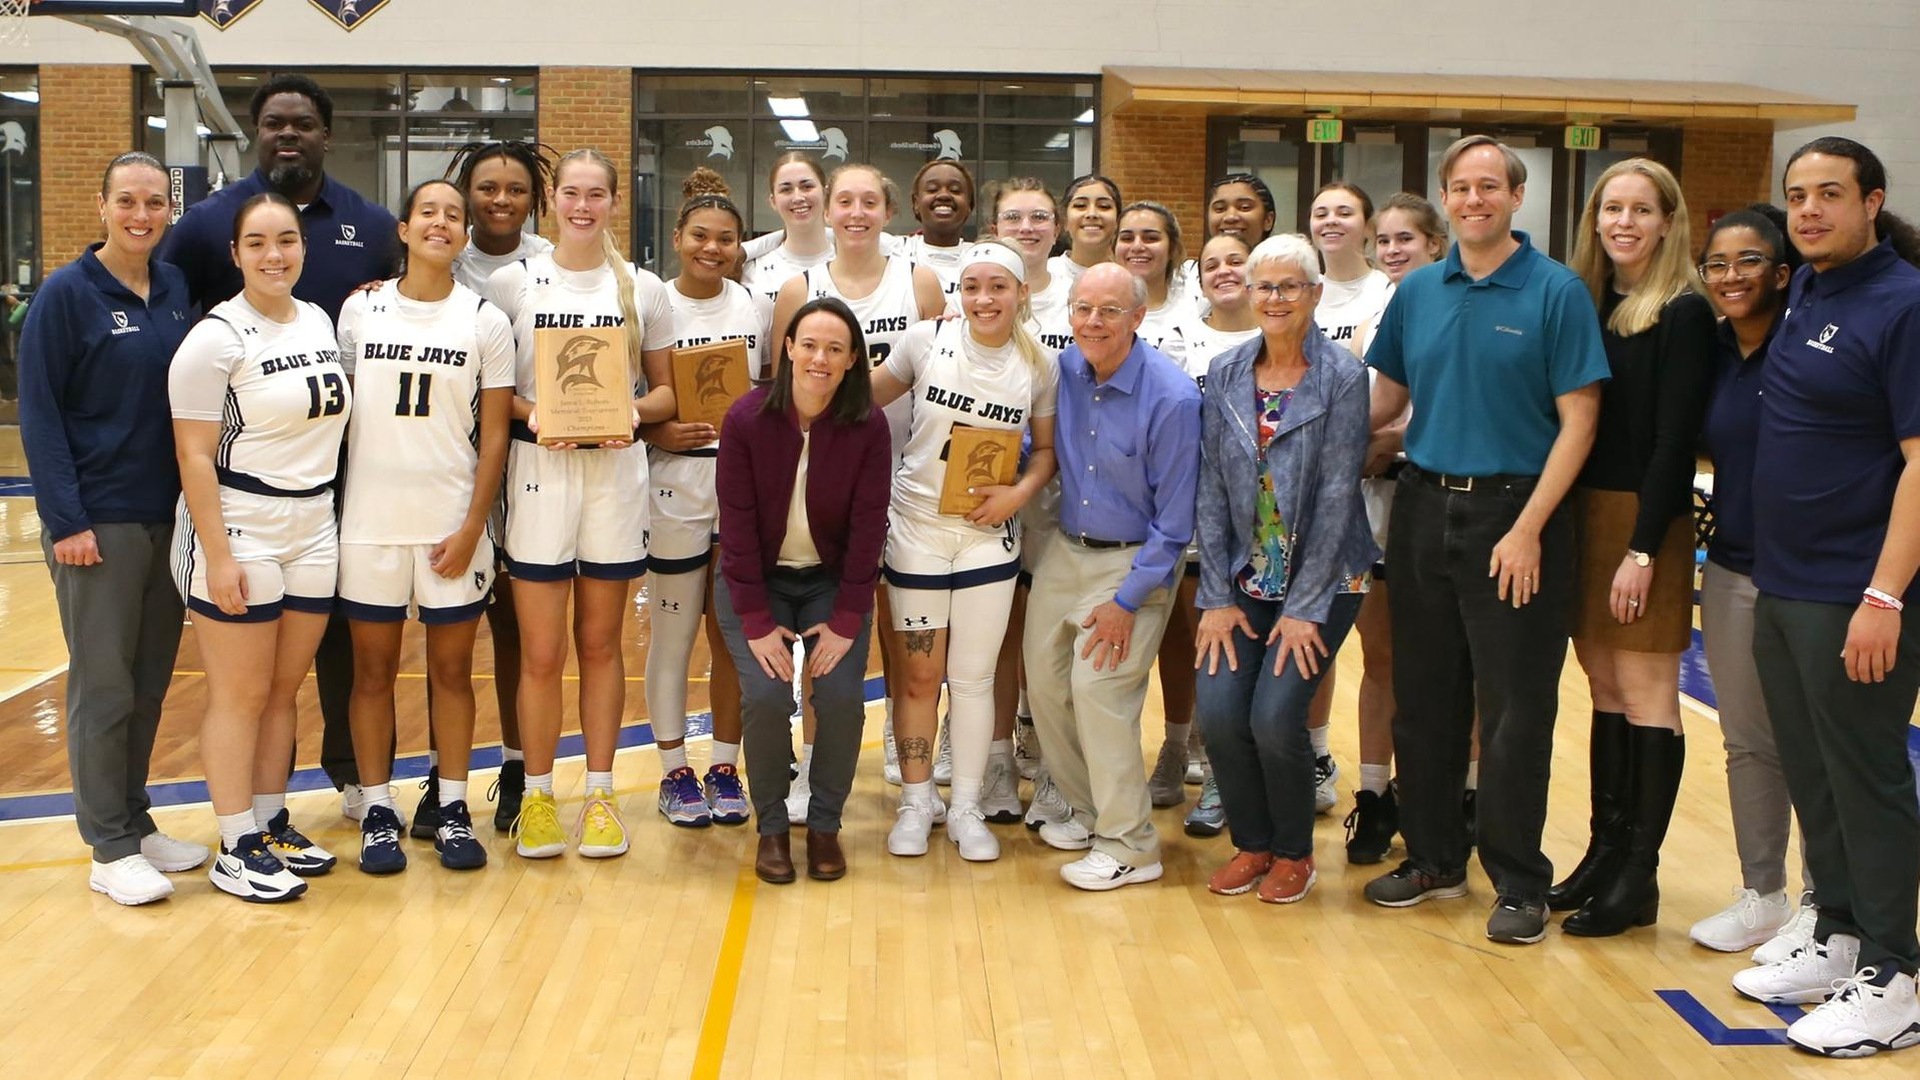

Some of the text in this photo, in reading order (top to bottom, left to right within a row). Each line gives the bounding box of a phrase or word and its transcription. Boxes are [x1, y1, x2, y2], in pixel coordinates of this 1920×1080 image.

[1313, 120, 1340, 141] EXIT
[1572, 127, 1597, 147] EXIT
[534, 313, 625, 328] BLUE JAY
[864, 315, 907, 334] JAYS
[261, 353, 312, 376] BLUE
[364, 343, 468, 367] BLUE JAYS
[305, 372, 346, 420] 13
[395, 371, 432, 417] 11
[925, 385, 1024, 425] BLUE JAYS
